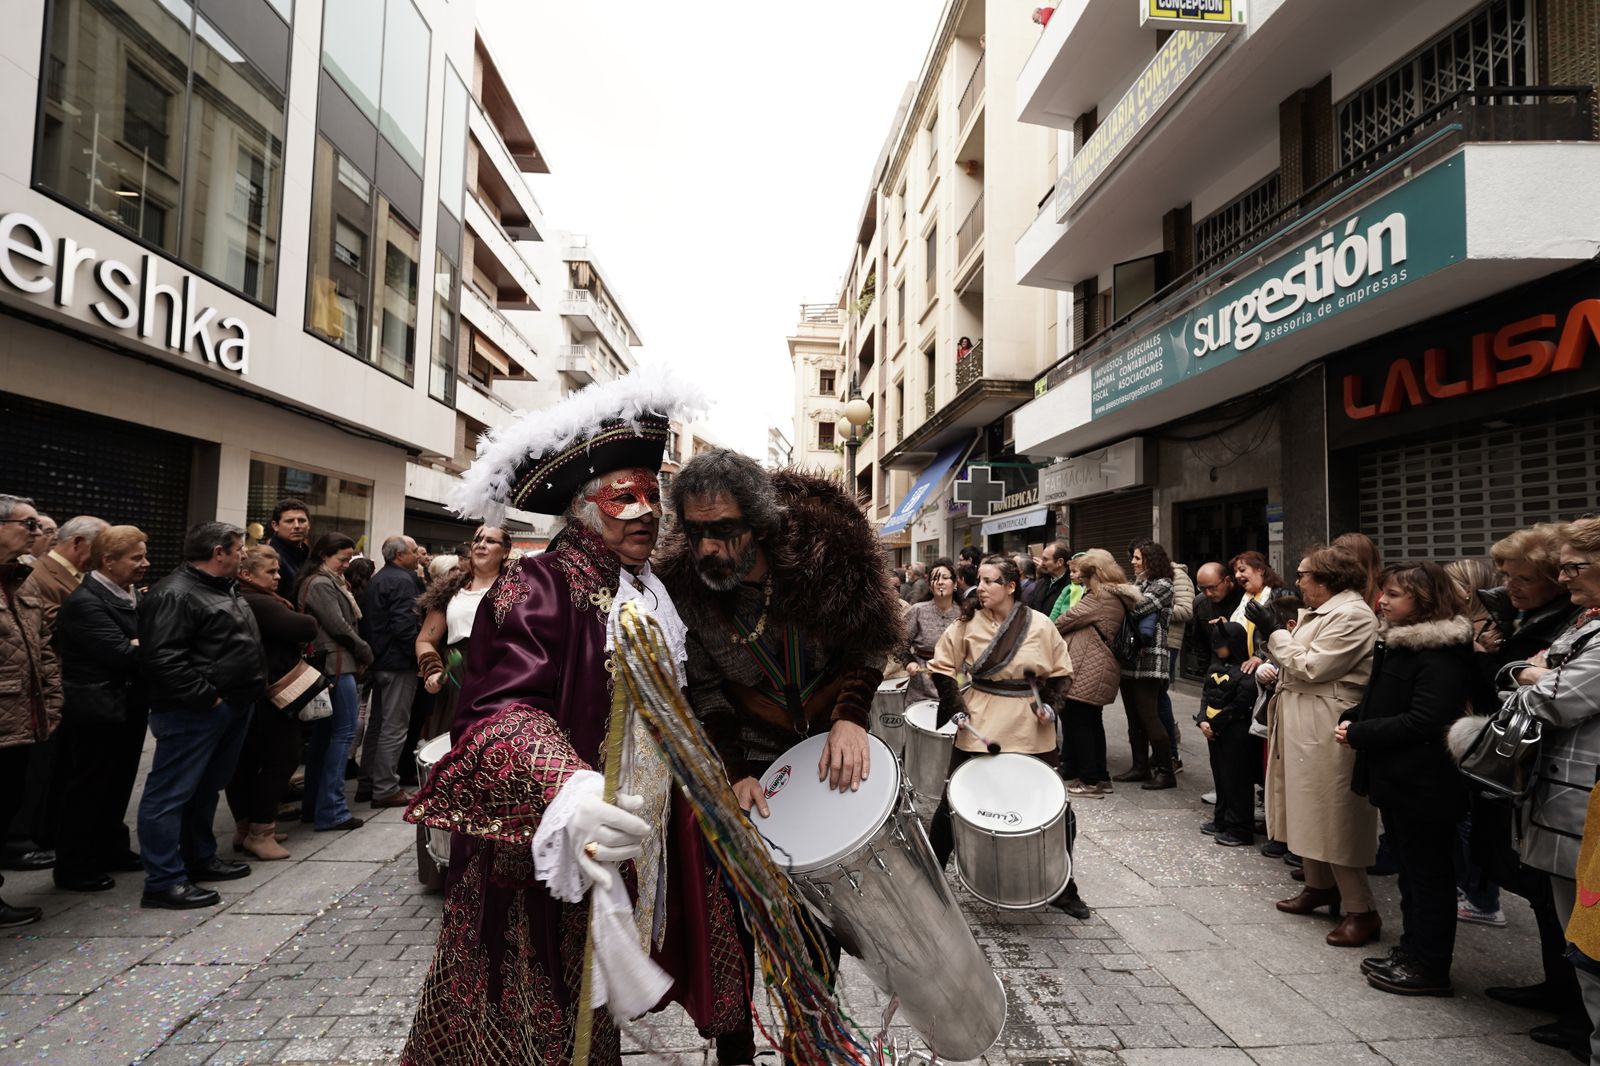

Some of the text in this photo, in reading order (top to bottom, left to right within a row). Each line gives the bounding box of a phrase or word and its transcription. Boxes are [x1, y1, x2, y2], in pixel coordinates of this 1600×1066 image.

[1152, 79, 1169, 110] 957
[1173, 61, 1187, 85] 48
[1188, 42, 1203, 68] 70
[1073, 30, 1203, 185] INMOBILIARIA CONCEPC
[1193, 212, 1408, 357] surgestión
[1318, 303, 1332, 317] de
[1338, 269, 1407, 308] empresas
[1093, 346, 1163, 391] LABORAL CONTABILIDAD
[1094, 333, 1161, 379] IMPUESTOS ESPECIALES
[1092, 360, 1163, 402] FISCAL ASOCIACIONES
[992, 487, 1040, 513] MONTEPICAZ
[977, 809, 1007, 821] LUEN
